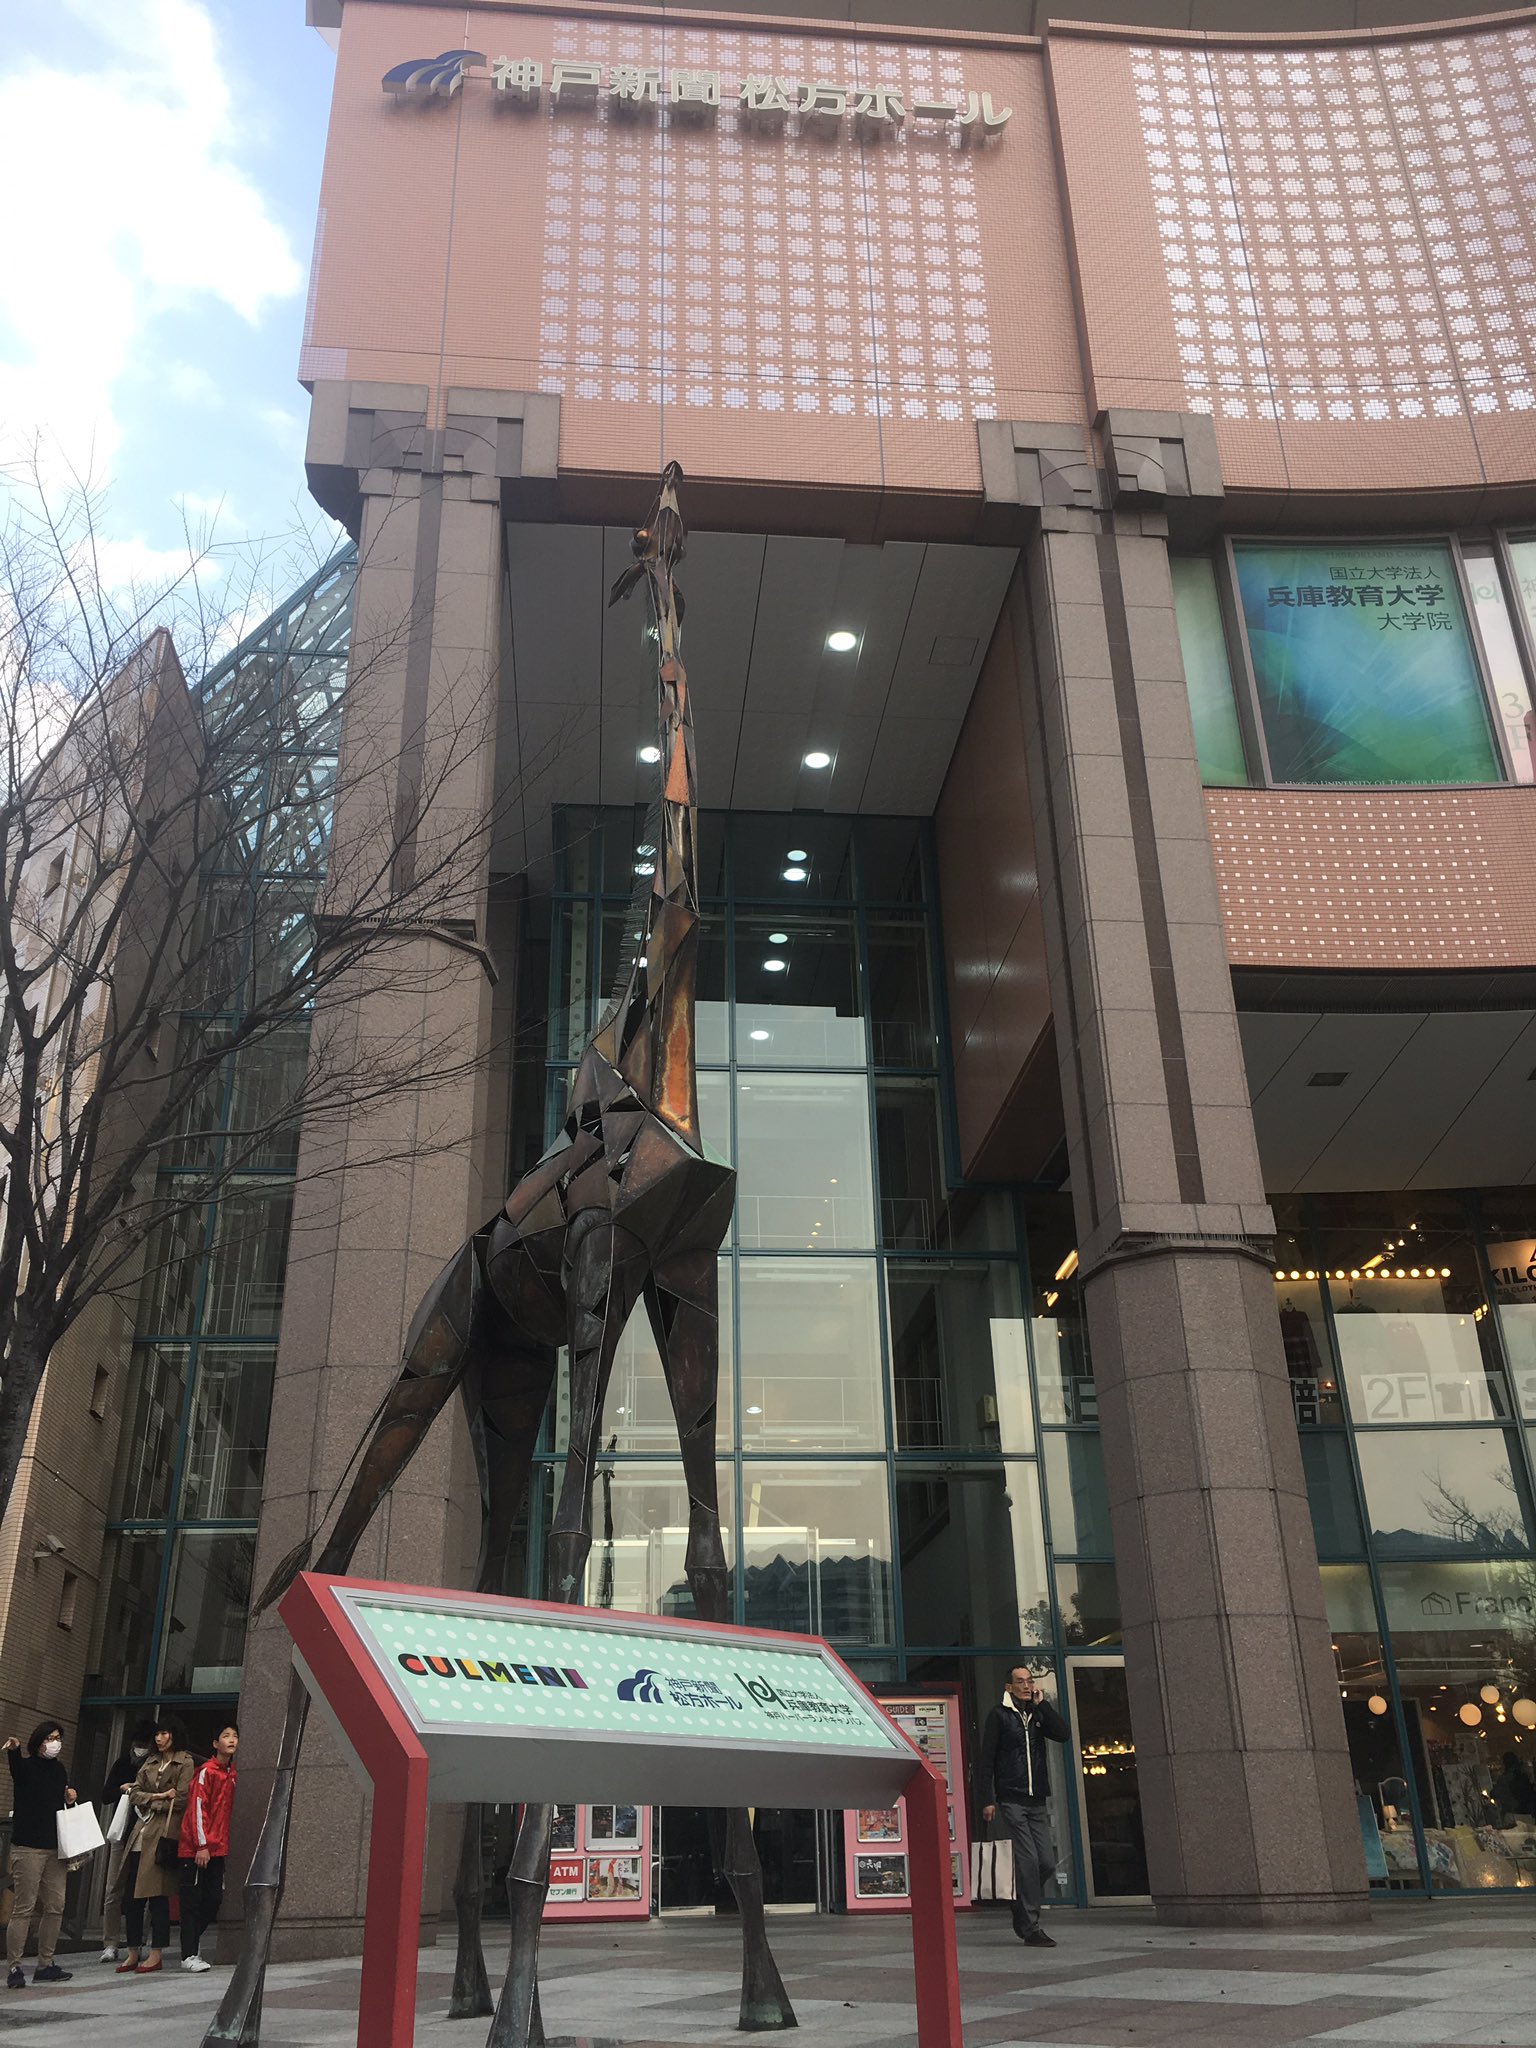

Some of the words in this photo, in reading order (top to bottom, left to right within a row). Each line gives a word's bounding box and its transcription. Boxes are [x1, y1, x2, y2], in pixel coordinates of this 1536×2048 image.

[490, 55, 721, 105] 神戸新聞
[739, 73, 1012, 125] 松方ホール
[1330, 566, 1440, 580] 国立大学法人
[1267, 585, 1445, 607] 兵庫教育大学
[1377, 612, 1453, 631] 大学院
[1367, 1376, 1427, 1418] 2F
[398, 1653, 590, 1689] CULMENI
[665, 1677, 723, 1694] 神戸新聞
[670, 1691, 743, 1710] 松方ホール
[786, 1700, 853, 1715] 兵庫教育大学
[885, 1705, 909, 1714] GUIDE
[553, 1866, 579, 1877] ATM
[549, 1888, 577, 1896] セブン銀行
